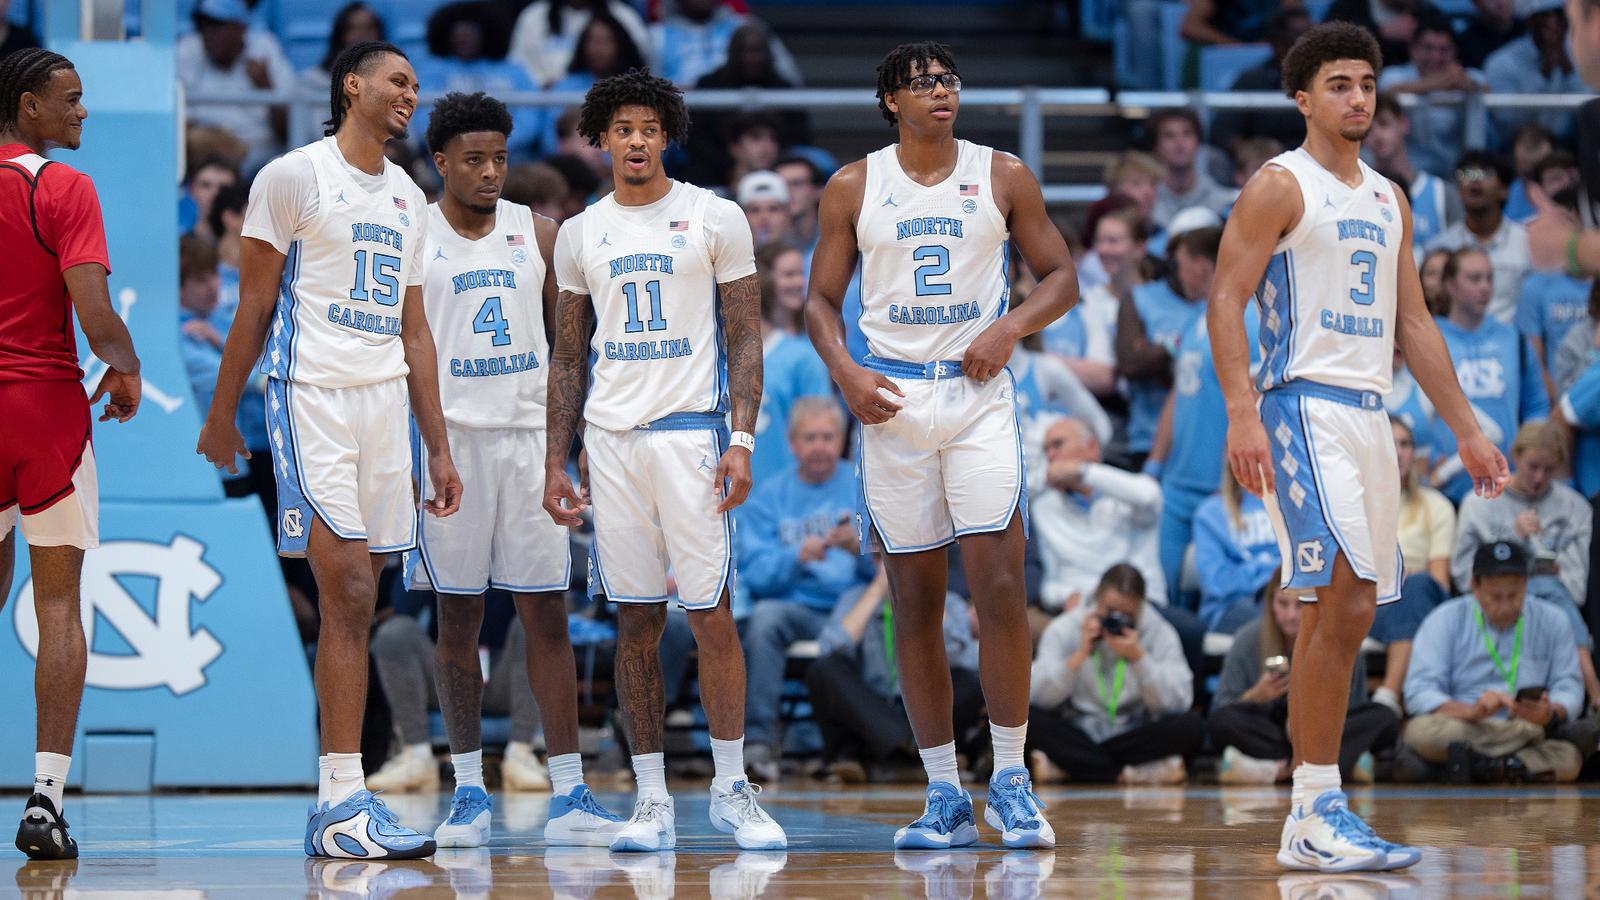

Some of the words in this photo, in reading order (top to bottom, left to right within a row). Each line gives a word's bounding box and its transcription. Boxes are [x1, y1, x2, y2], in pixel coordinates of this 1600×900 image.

[351, 222, 403, 251] NORTH
[896, 217, 963, 240] NORTH
[1337, 218, 1387, 247] NORTH
[350, 249, 401, 307] 15
[609, 253, 674, 279] NORTH
[913, 244, 952, 297] 2
[1350, 249, 1378, 306] 3
[452, 269, 517, 295] NORTH
[328, 303, 401, 336] CAROLIN
[621, 279, 667, 333] 11
[889, 301, 981, 325] CAROLINA
[472, 296, 512, 347] 4
[1320, 308, 1384, 338] CAROLI
[604, 337, 693, 361] CAROLINA
[450, 351, 540, 377] CAROLINA
